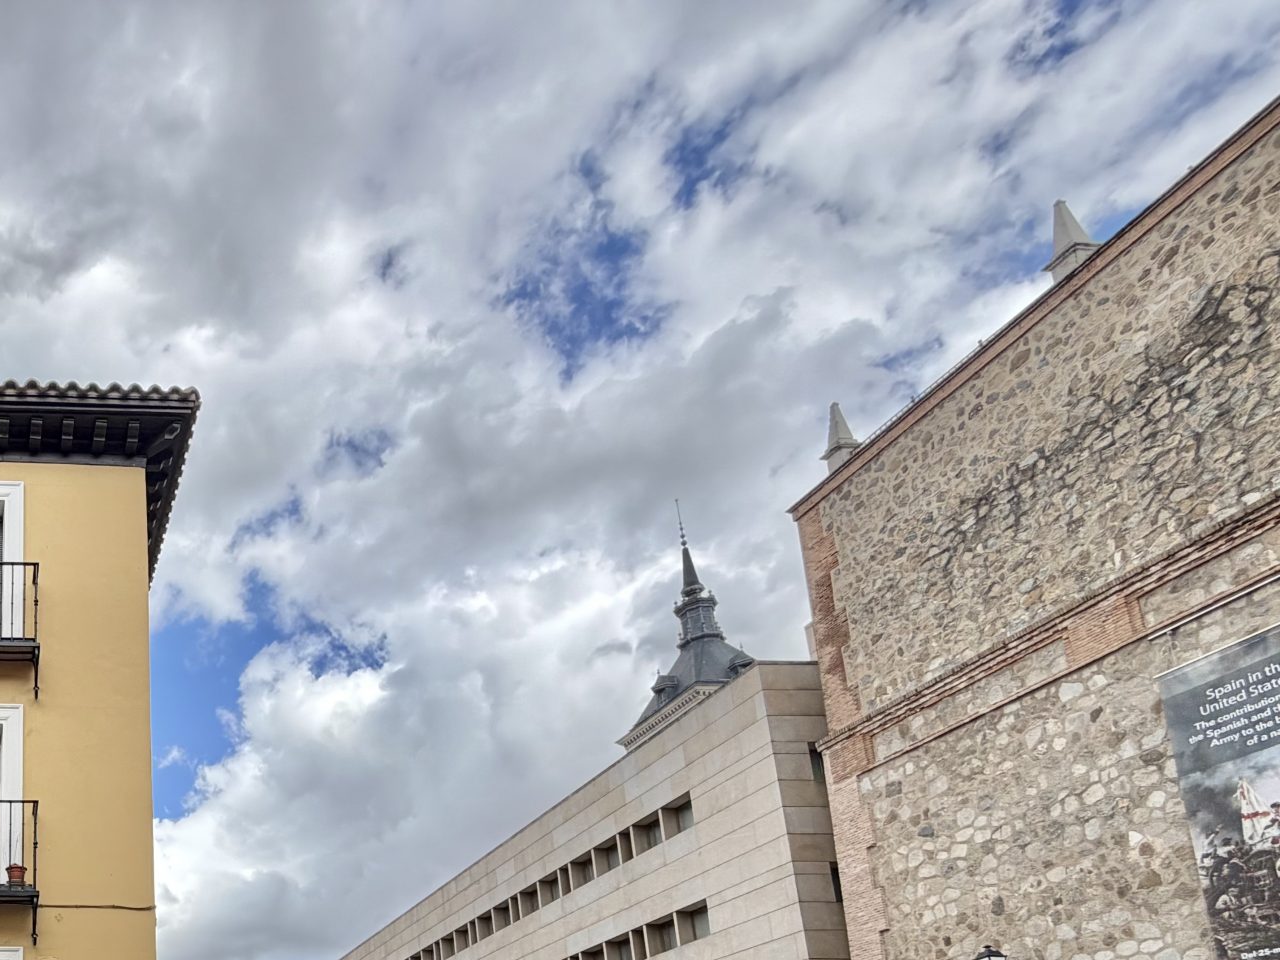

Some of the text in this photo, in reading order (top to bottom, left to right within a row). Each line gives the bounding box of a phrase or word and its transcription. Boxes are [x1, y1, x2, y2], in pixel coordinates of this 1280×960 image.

[1206, 679, 1245, 700] Spain
[1248, 672, 1262, 683] in
[1200, 689, 1247, 715] United
[1189, 734, 1204, 744] the
[1206, 717, 1249, 737] Spanish
[1251, 707, 1272, 721] and
[1193, 720, 1216, 730] The
[1210, 732, 1240, 747] Army
[1241, 728, 1254, 736] to
[1255, 720, 1274, 731] the
[1246, 735, 1259, 746] of
[1258, 948, 1280, 957] 25-m
